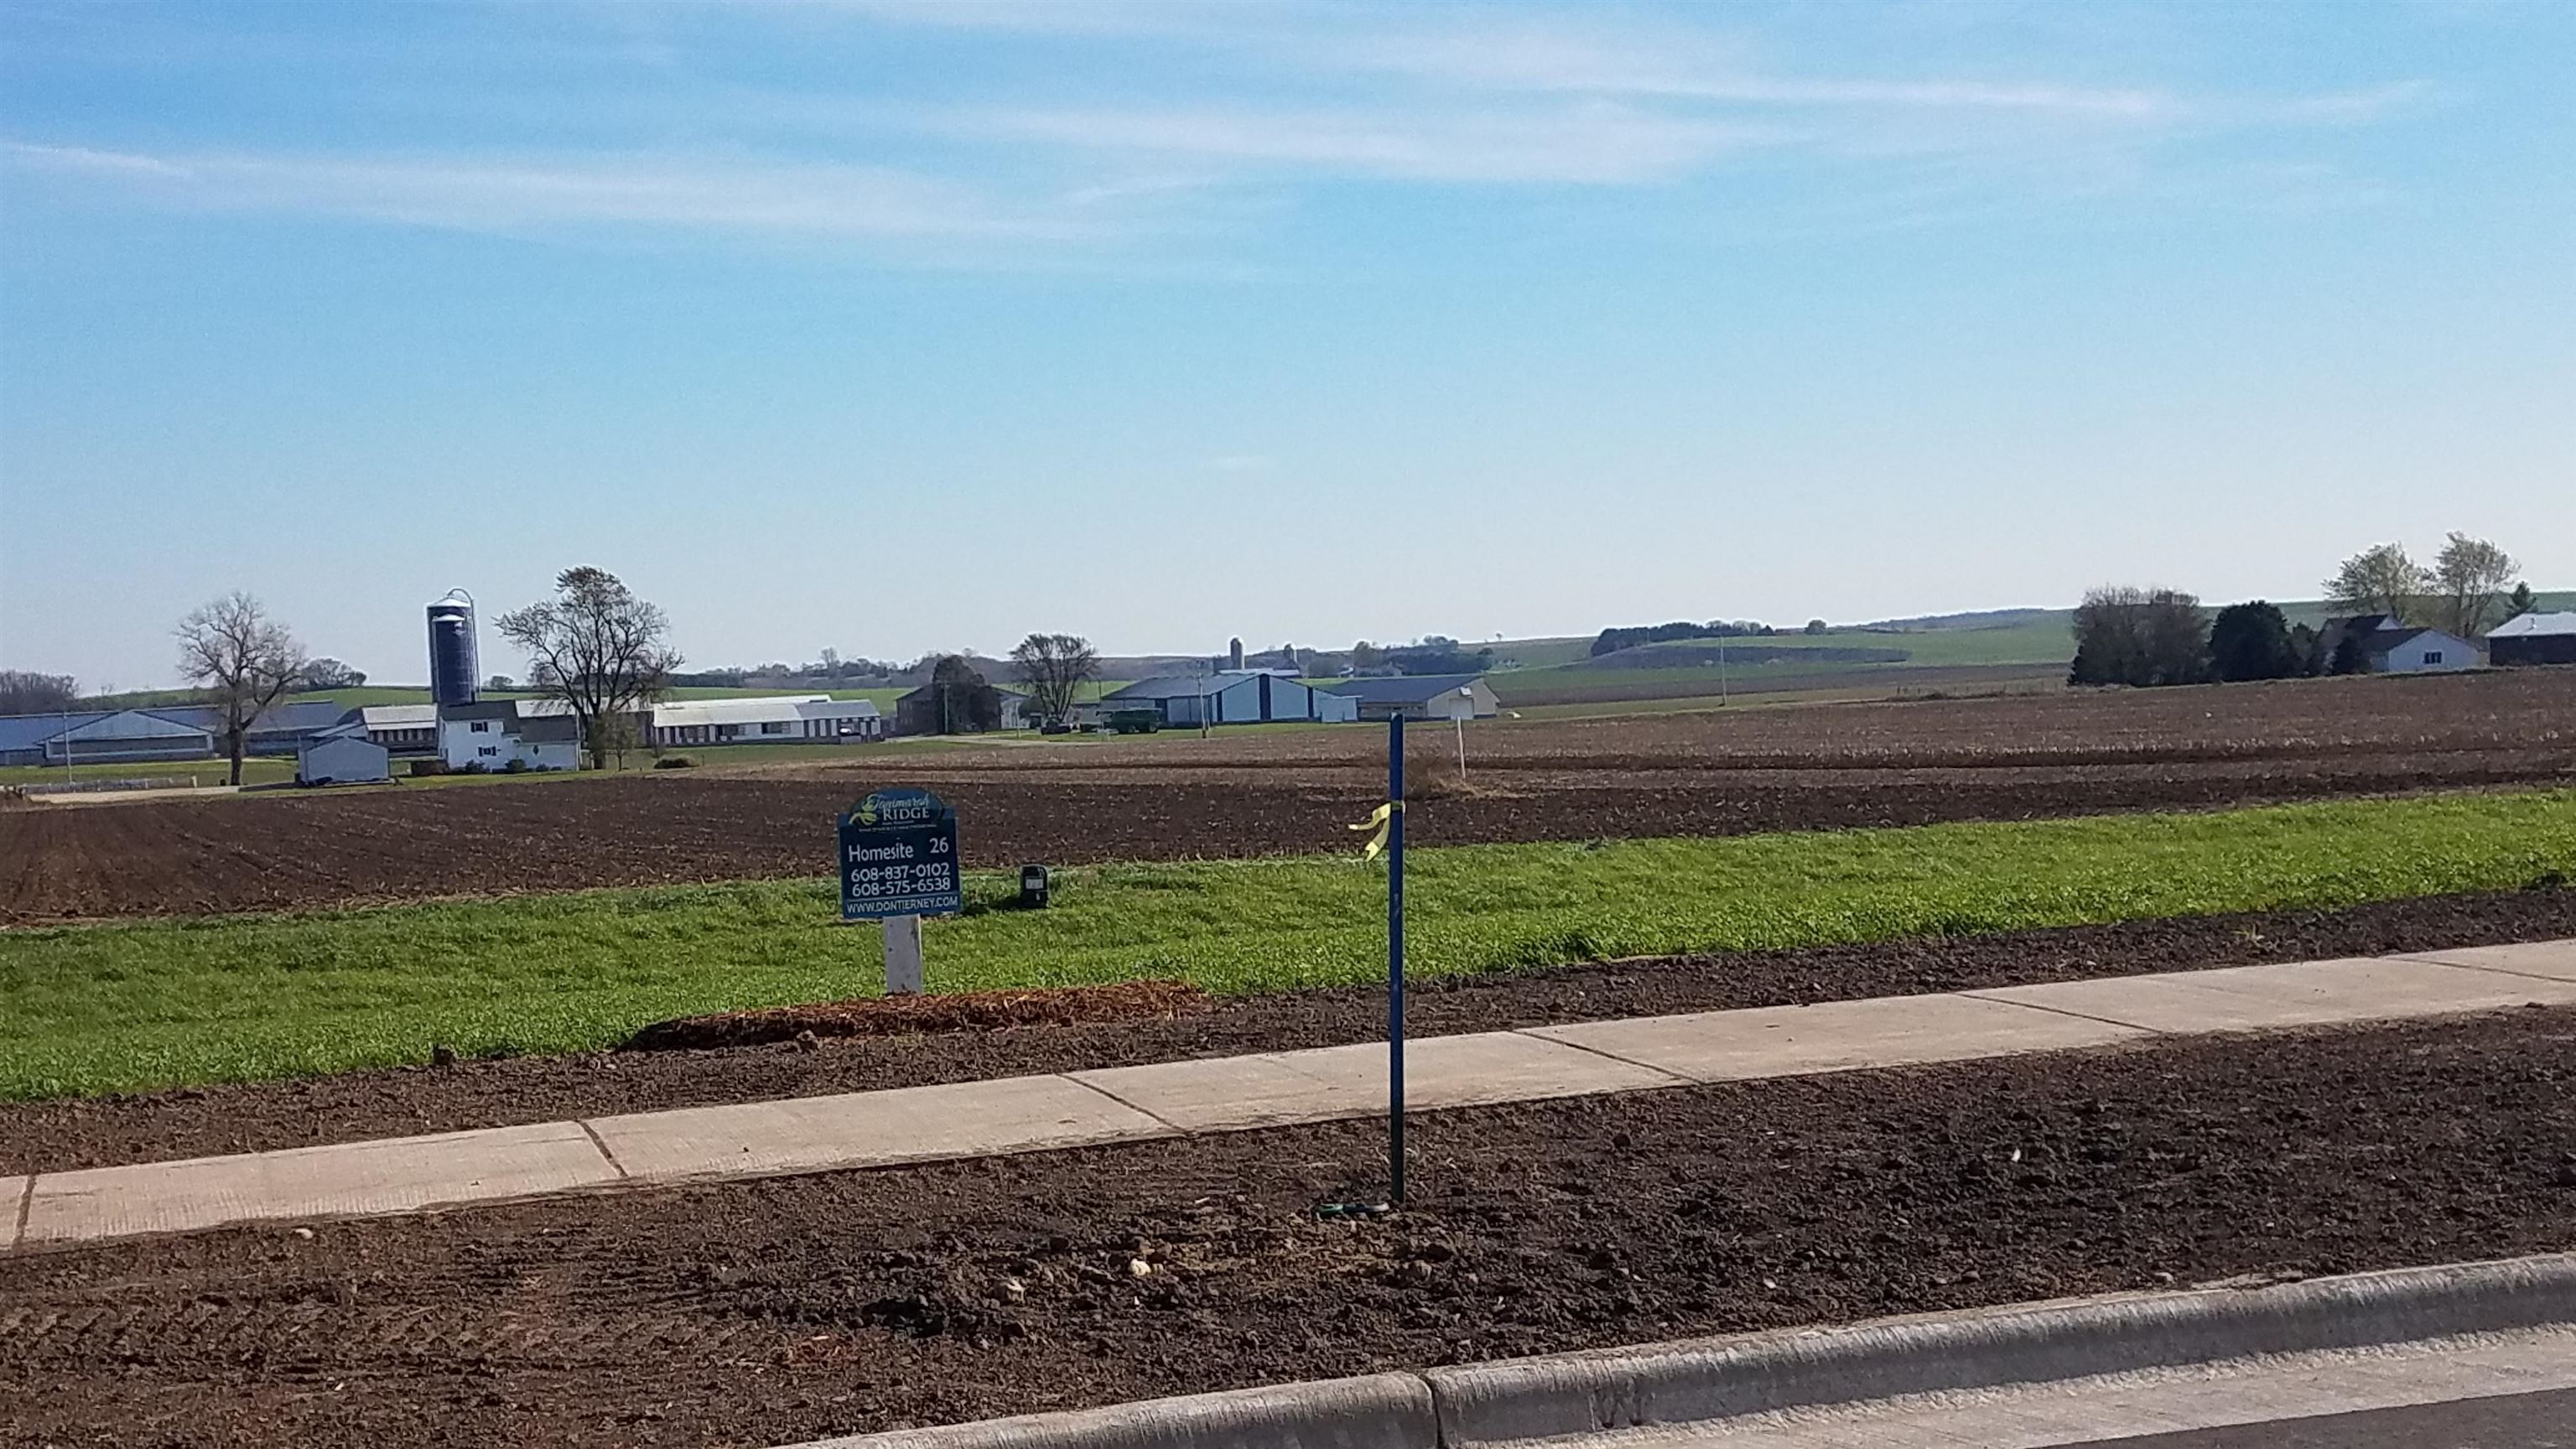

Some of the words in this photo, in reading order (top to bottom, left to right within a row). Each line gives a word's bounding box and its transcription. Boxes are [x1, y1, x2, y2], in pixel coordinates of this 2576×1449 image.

[883, 808, 930, 821] RIDGE
[848, 843, 914, 862] Homesite
[929, 837, 948, 854] 26
[851, 862, 950, 882] 608-837-0102
[852, 877, 951, 896] 608-575-6538
[847, 896, 958, 913] WWW.DONTIERNEY.COM
